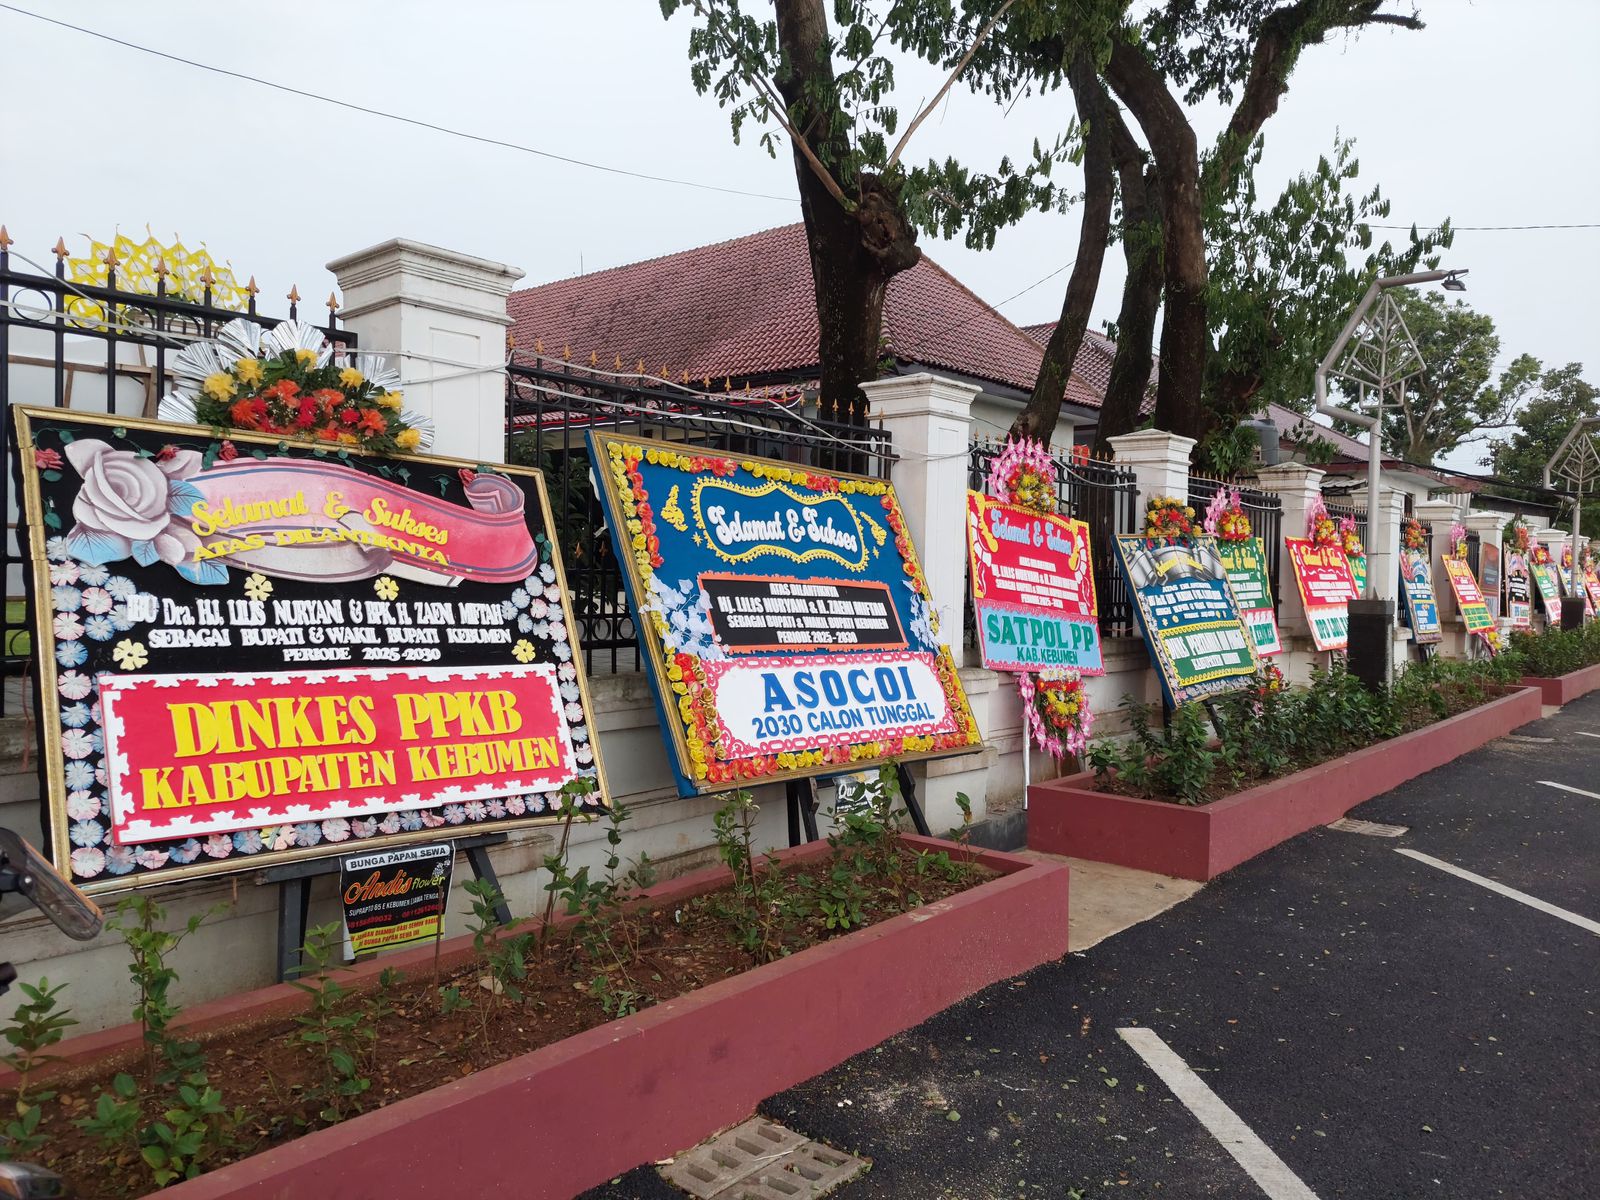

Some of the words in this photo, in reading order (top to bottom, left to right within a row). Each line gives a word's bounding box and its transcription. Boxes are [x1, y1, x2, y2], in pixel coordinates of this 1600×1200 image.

[191, 490, 309, 537] Selamat
[322, 491, 350, 519] &
[363, 497, 448, 545] Sukses
[707, 505, 786, 545] Selamat
[786, 508, 806, 543] &
[802, 506, 858, 553] Sukses
[192, 534, 266, 562] ATAS
[273, 527, 450, 566] DILANTIKNYA
[162, 598, 196, 626] Dra.
[227, 600, 267, 626] LILIS
[272, 599, 345, 625] NURYANI
[349, 598, 364, 624] &
[458, 602, 505, 626] MIFTAH
[727, 615, 767, 629] SEBAGAI
[808, 602, 818, 614] &
[148, 628, 232, 649] SEBAGAI
[240, 627, 306, 647] BUPATI
[308, 627, 325, 645] &
[325, 626, 382, 645] WAKIL
[386, 628, 441, 644] BUPATI
[446, 628, 513, 644] KEBUMEN
[777, 631, 813, 644] PERIODE
[986, 614, 1069, 651] SATPOL
[1071, 623, 1095, 652] PP
[282, 647, 352, 662] PERIODE
[1041, 648, 1079, 665] KEBUMEN
[762, 666, 918, 713] ASOCOI
[166, 695, 377, 758] DINKES
[393, 689, 523, 741] PPKB
[752, 713, 804, 740] 2030
[807, 709, 863, 732] CALON
[865, 703, 936, 726] TUNGGAL
[141, 749, 397, 810] KABUPATEN
[405, 736, 560, 783] KEBUMEN
[350, 857, 386, 869] BUNGA
[388, 851, 418, 863] PAPAN
[420, 847, 446, 858] SEWA
[411, 876, 446, 890] flower
